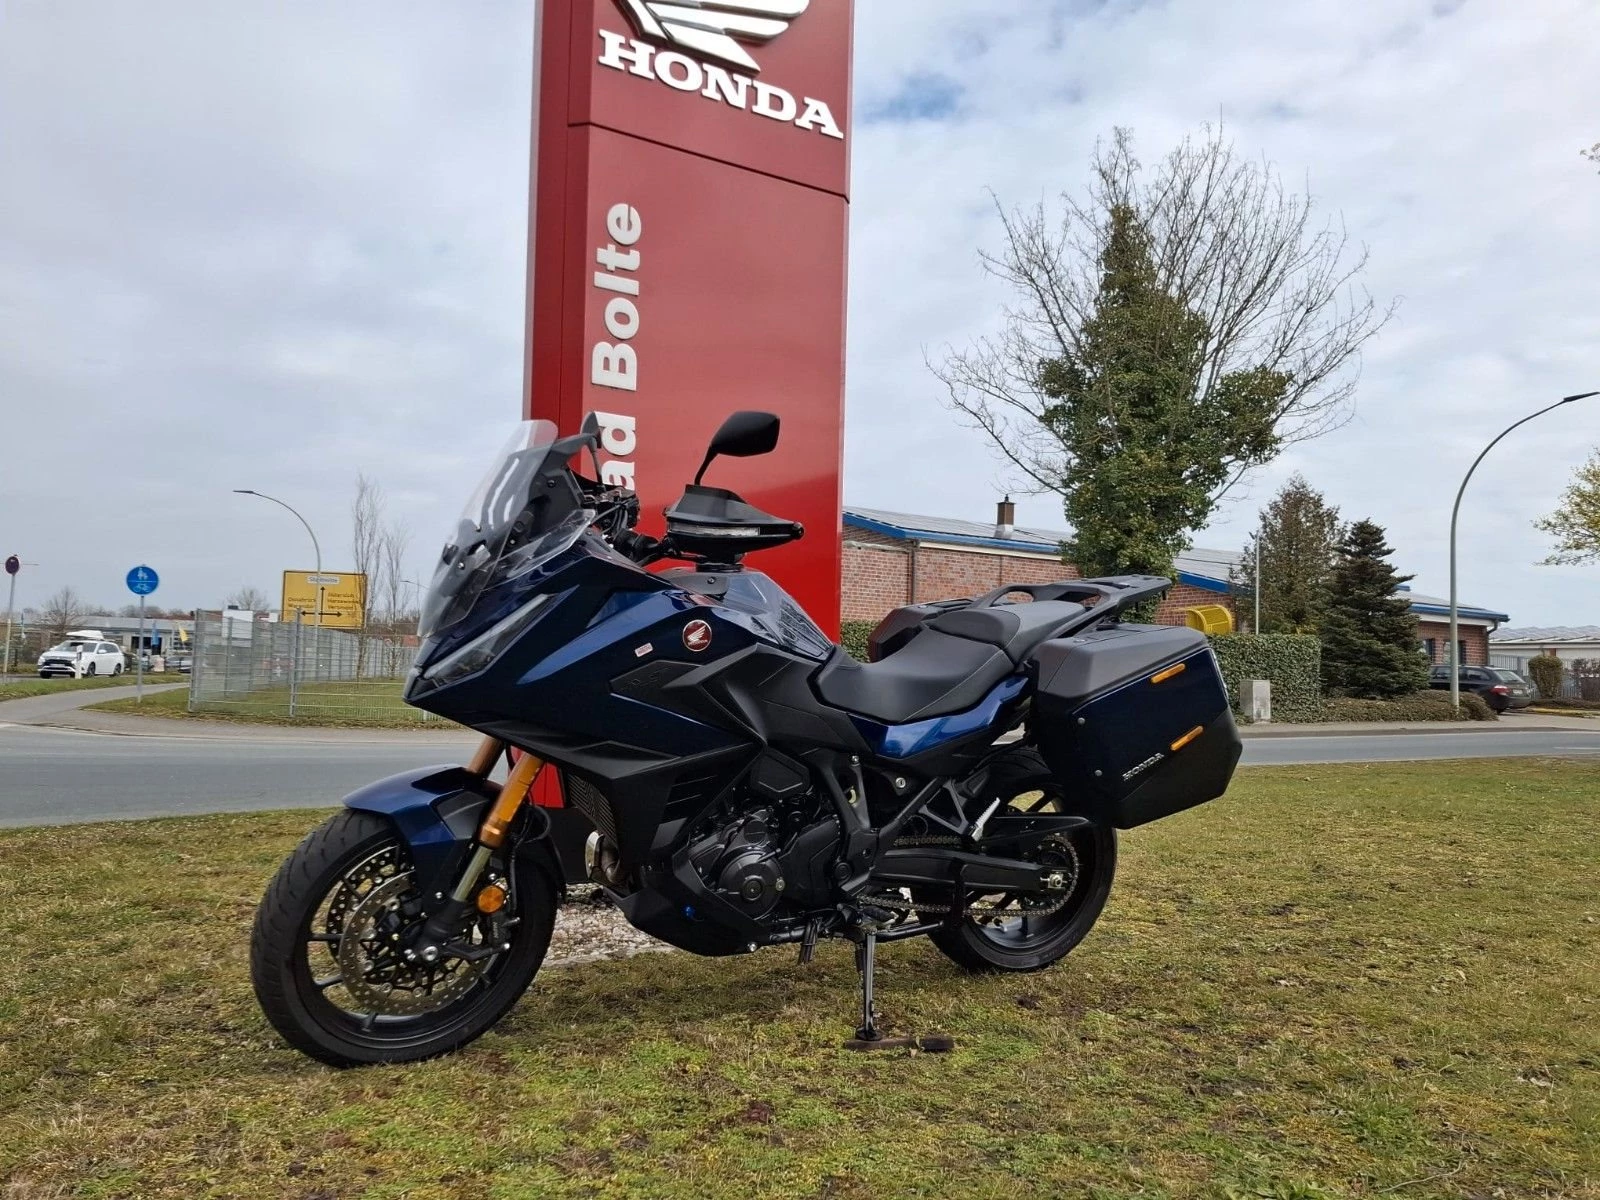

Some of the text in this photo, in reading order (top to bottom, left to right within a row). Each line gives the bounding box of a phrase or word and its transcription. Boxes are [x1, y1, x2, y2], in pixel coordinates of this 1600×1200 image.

[598, 29, 844, 139] HONDA
[592, 202, 642, 391] Bolte
[1122, 752, 1165, 781] HONDA
